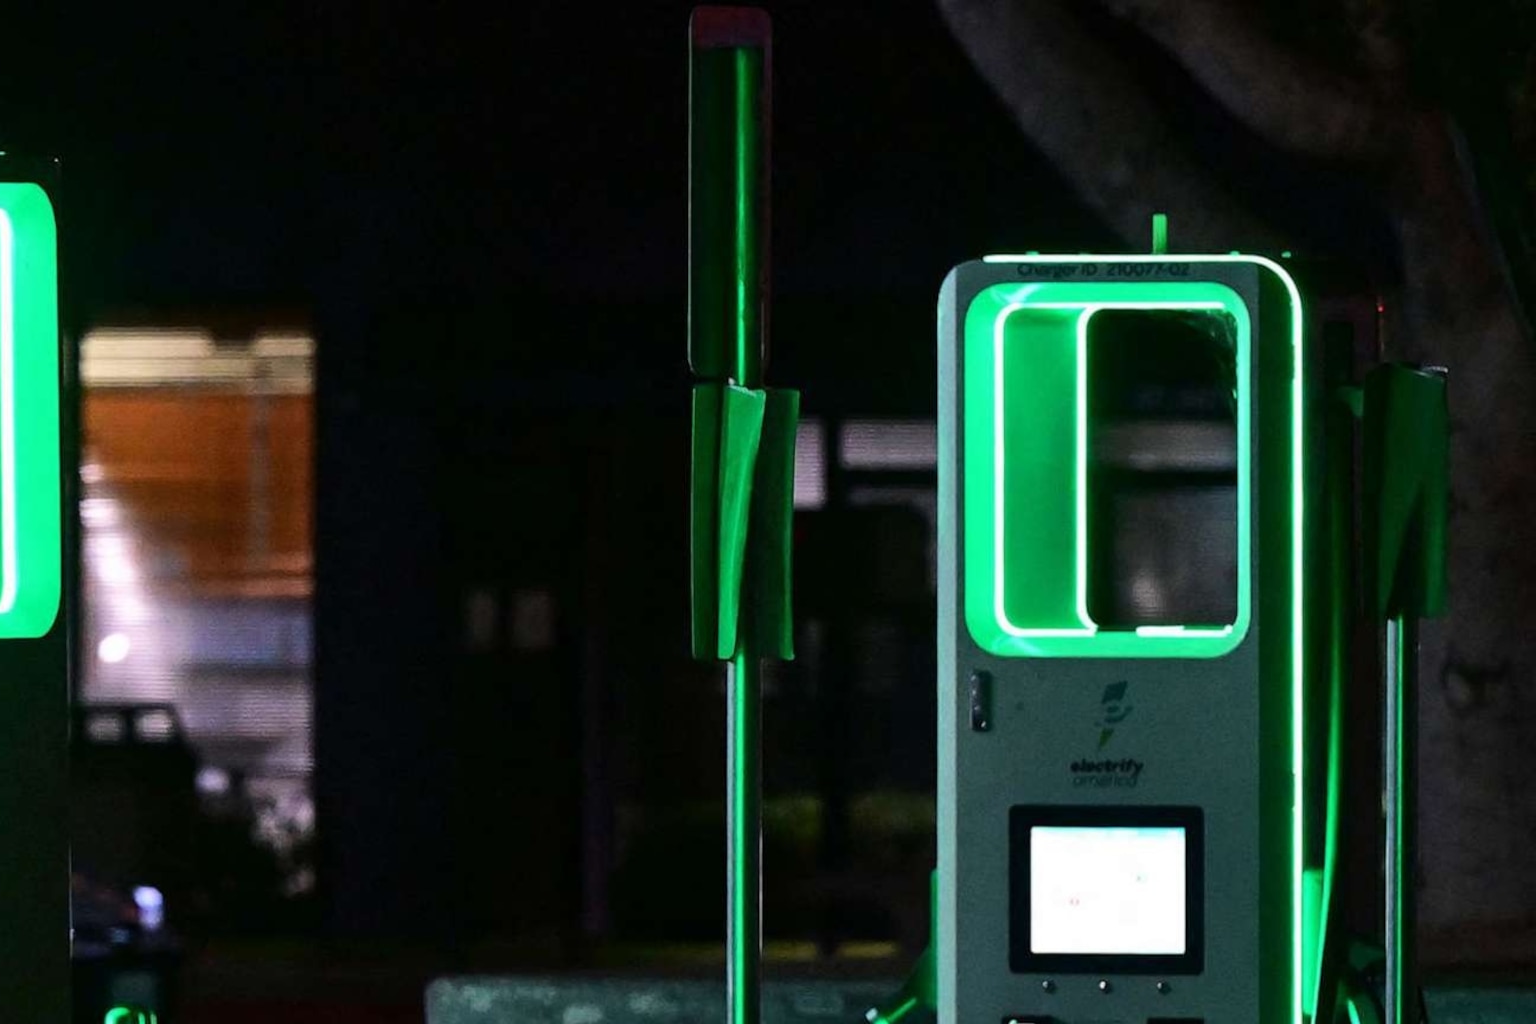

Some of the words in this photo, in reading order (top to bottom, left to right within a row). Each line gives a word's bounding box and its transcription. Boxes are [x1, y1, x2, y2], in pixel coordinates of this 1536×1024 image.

[1017, 264, 1077, 278] Charger
[1081, 263, 1099, 277] ID
[1070, 758, 1143, 778] electrify
